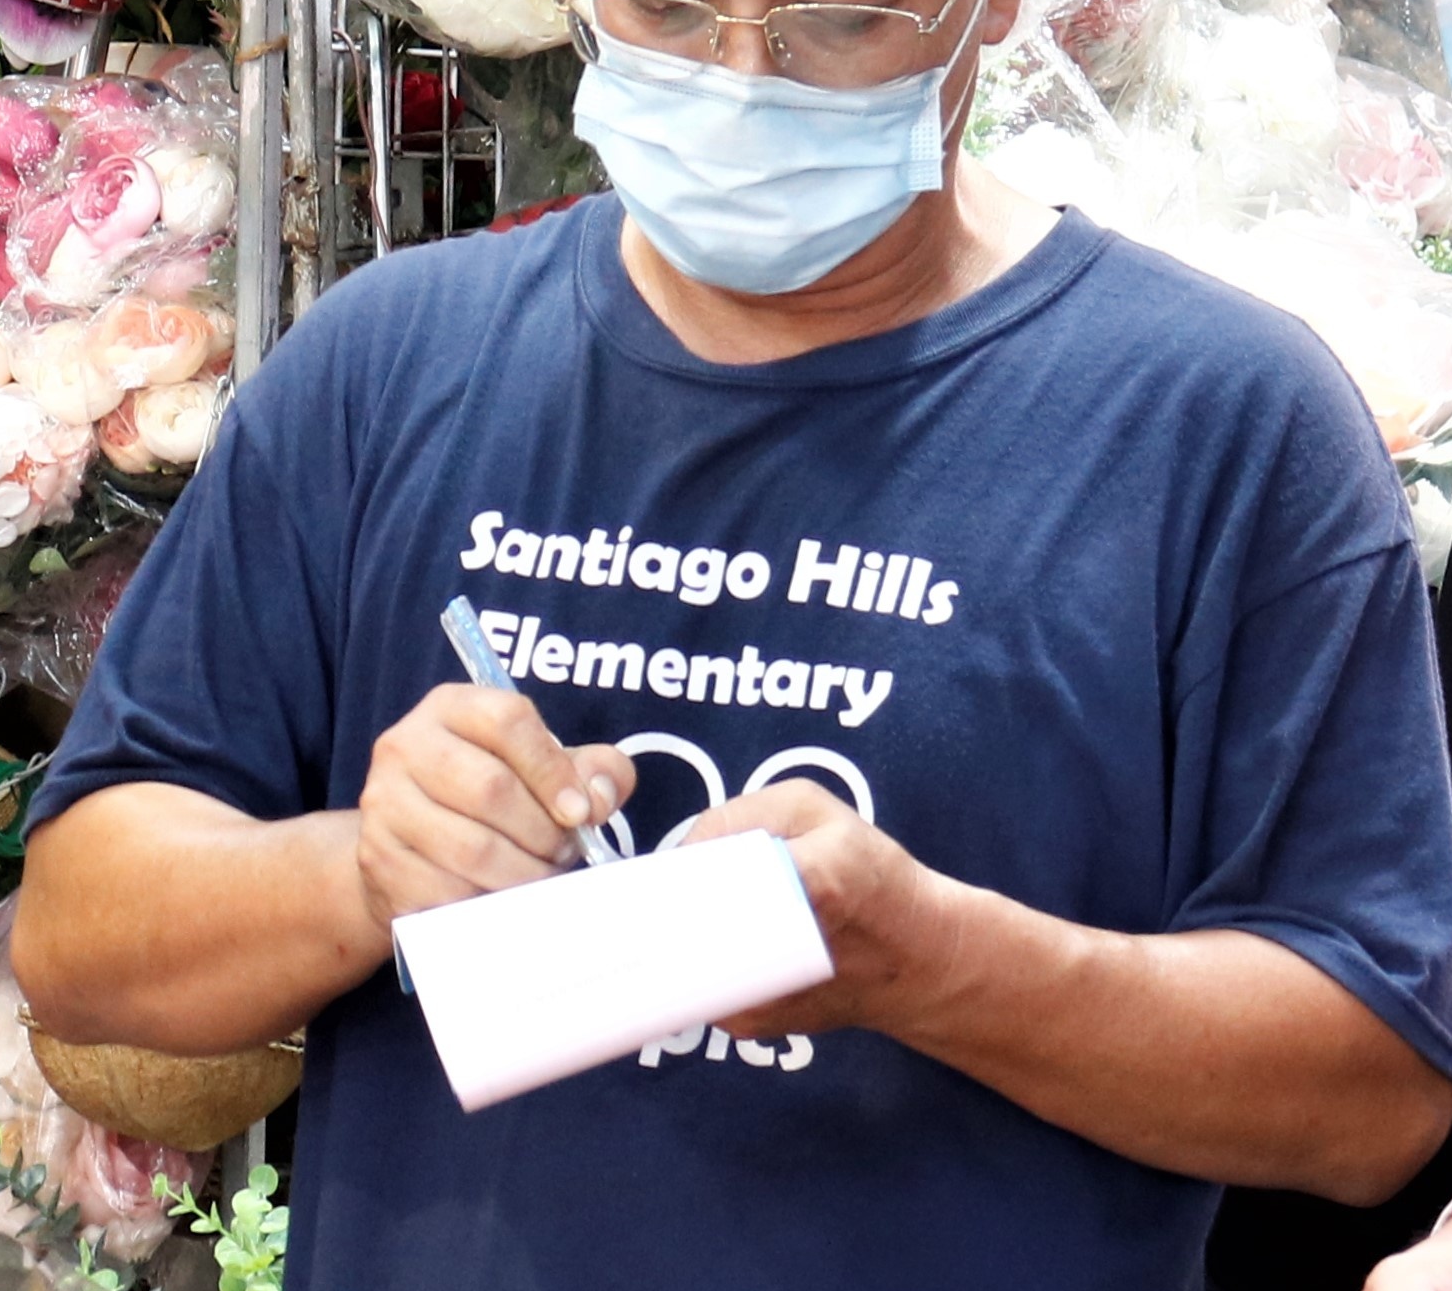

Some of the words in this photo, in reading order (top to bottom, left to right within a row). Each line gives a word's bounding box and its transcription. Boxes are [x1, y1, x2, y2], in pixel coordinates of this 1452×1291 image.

[460, 510, 771, 606] Santiago
[787, 538, 960, 626] Hills
[478, 609, 894, 728] Elementary
